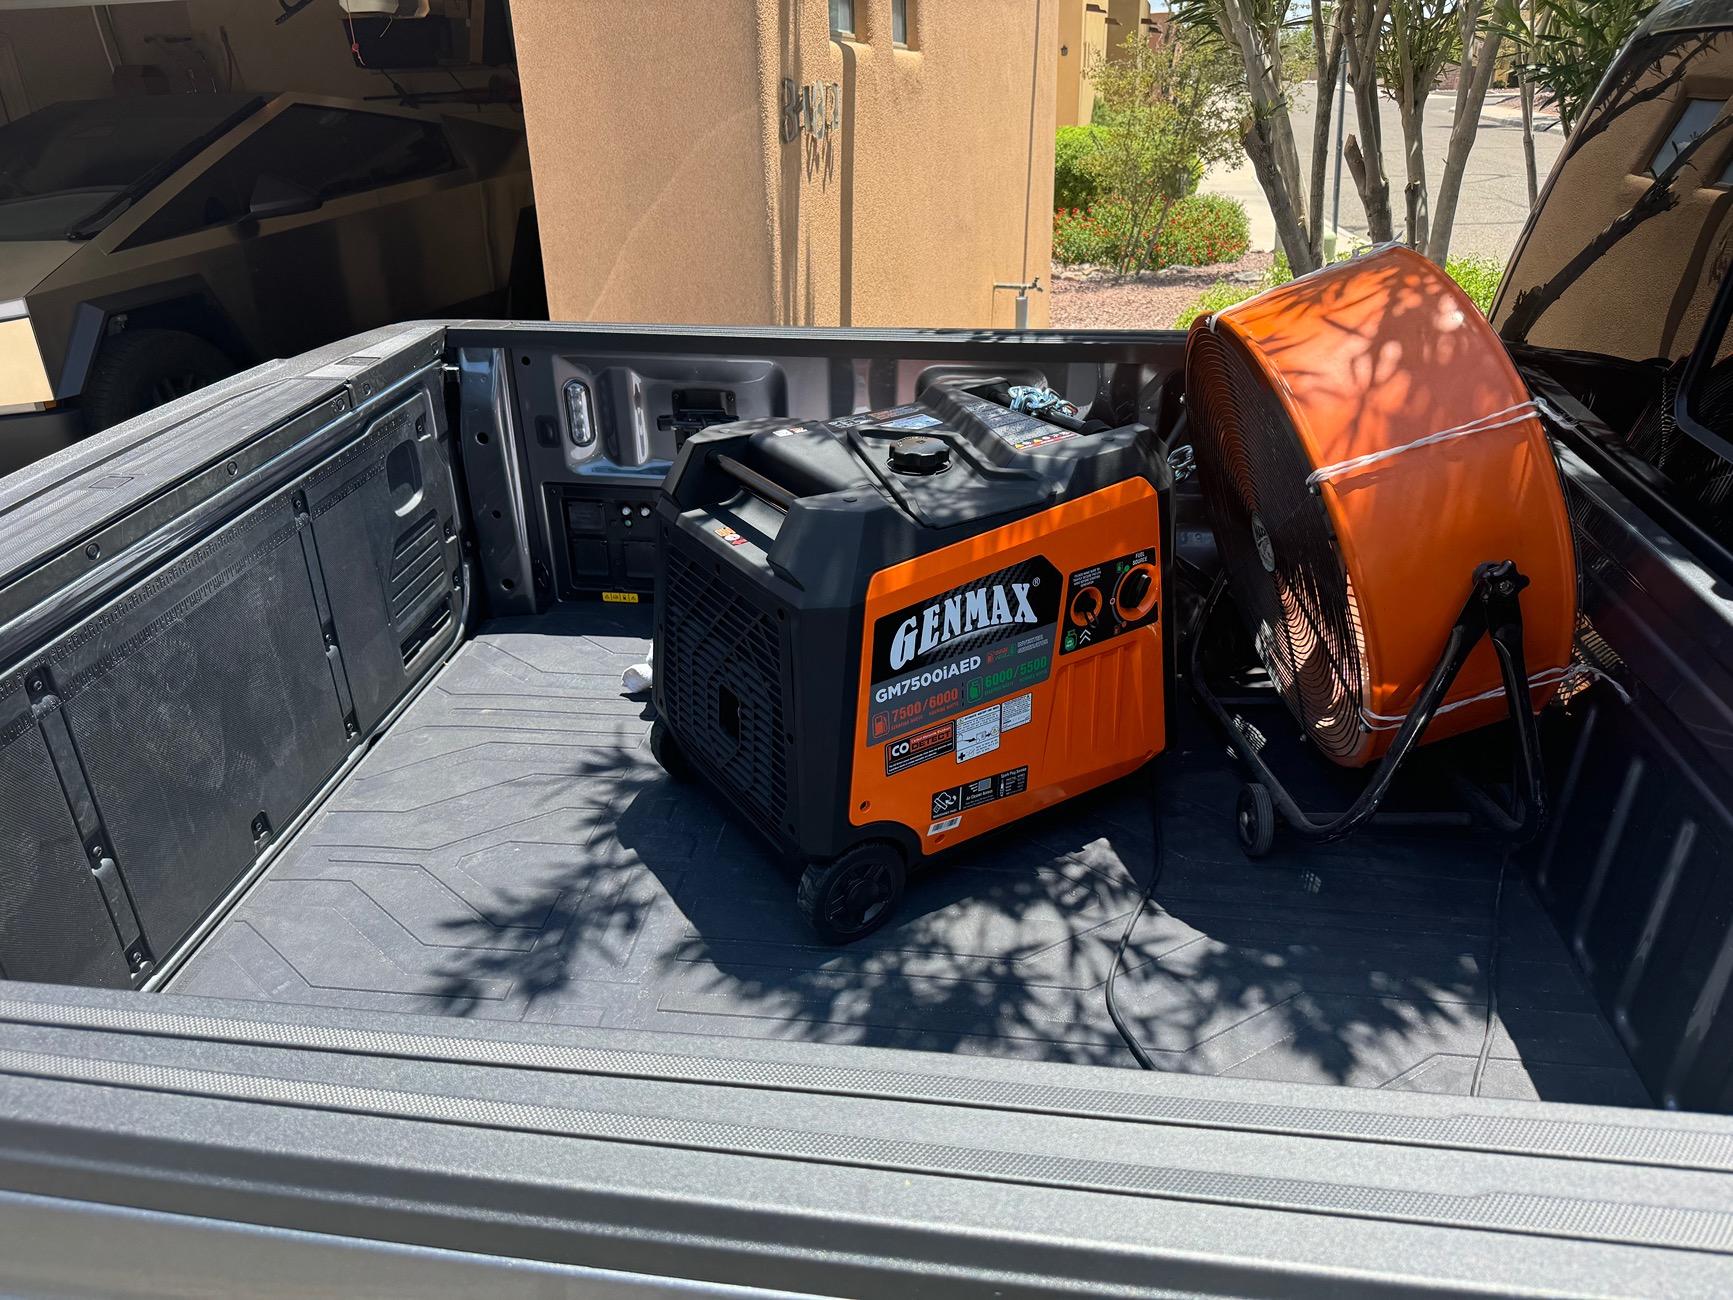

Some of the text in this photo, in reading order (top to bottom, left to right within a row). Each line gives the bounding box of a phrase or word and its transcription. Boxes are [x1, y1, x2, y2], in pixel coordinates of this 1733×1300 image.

[889, 583, 1038, 671] GENMAX
[875, 655, 982, 703] GM7500iAED
[984, 655, 1048, 688] 6000/5500
[891, 687, 959, 722] 7500/6000
[891, 742, 910, 757] CO
[911, 730, 952, 750] DETECT
